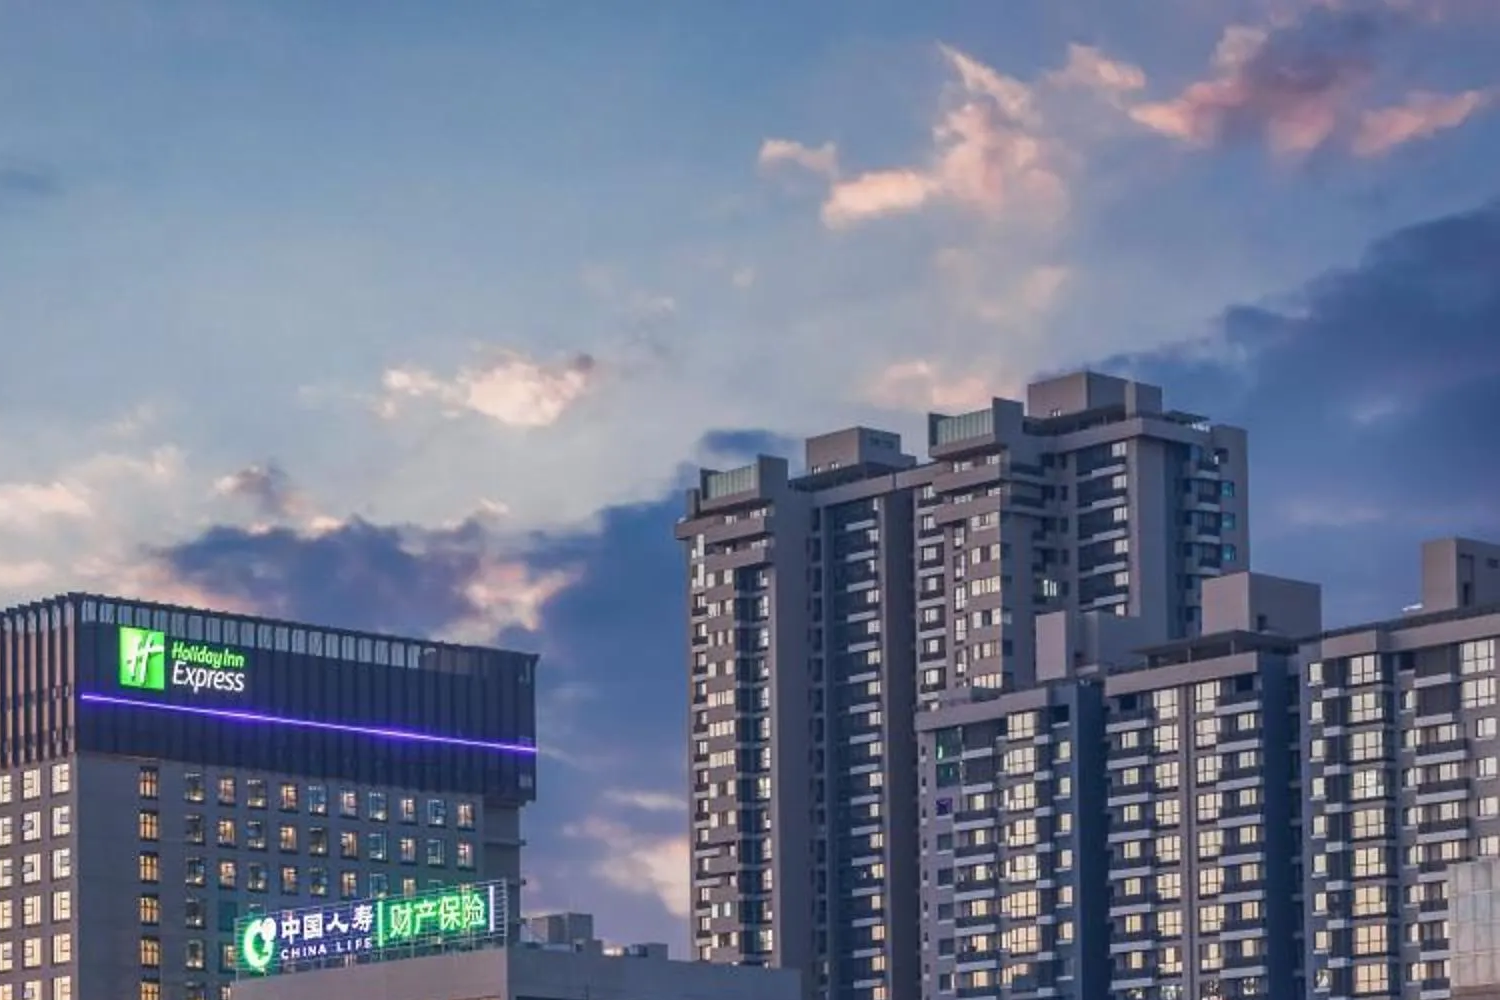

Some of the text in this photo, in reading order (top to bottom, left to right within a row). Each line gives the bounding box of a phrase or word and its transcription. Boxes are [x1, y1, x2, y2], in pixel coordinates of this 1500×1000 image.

[172, 640, 245, 669] Holiday Inn
[172, 659, 245, 695] Express
[280, 893, 487, 946] 中国人寿 财产保险
[280, 943, 328, 961] CHINA
